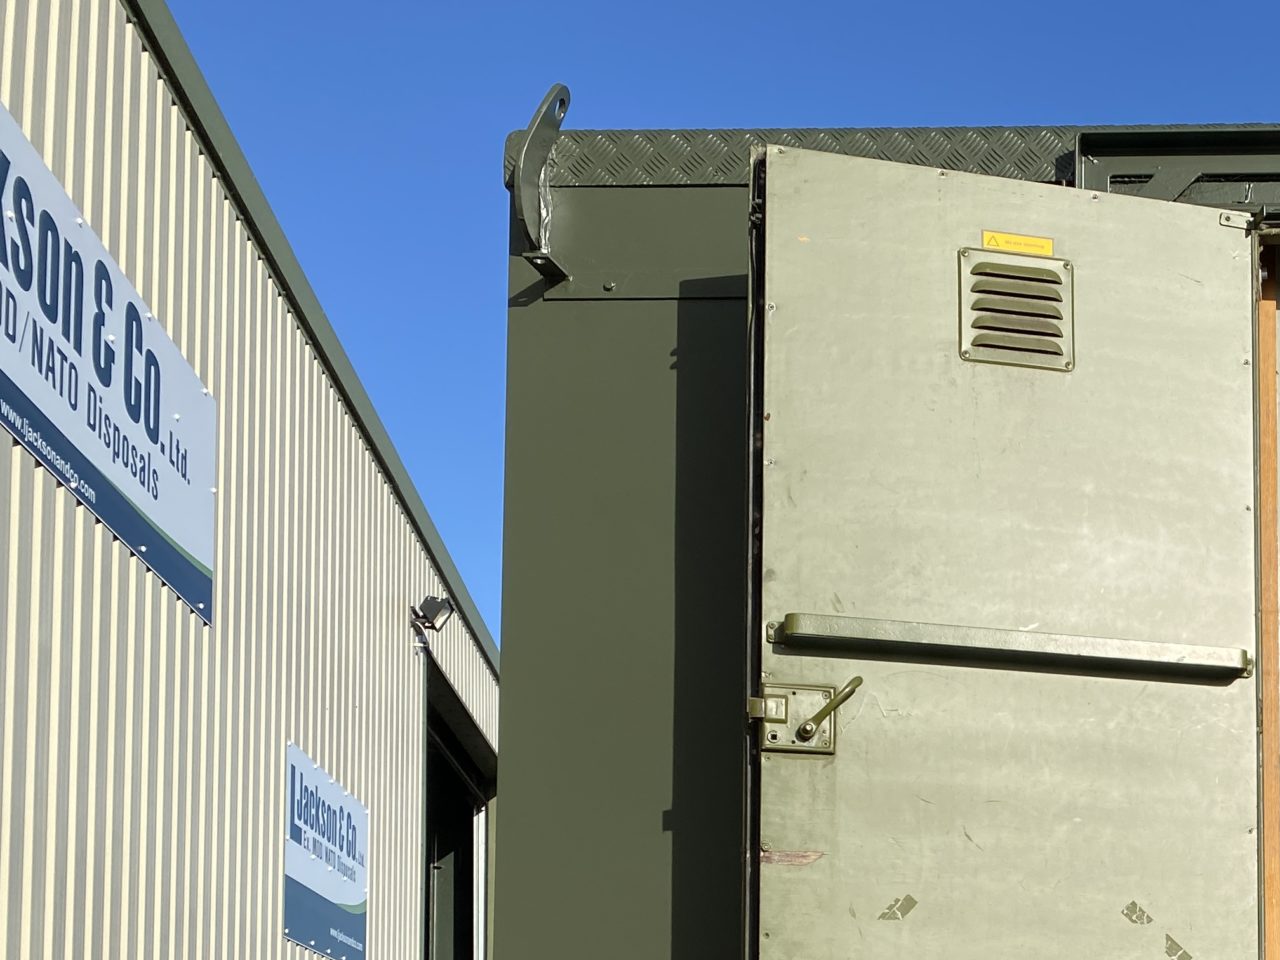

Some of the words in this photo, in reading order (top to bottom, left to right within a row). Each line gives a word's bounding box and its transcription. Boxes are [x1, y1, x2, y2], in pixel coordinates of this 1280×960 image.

[0, 281, 78, 412] D/NATO
[86, 382, 159, 501] Disposals
[0, 398, 97, 504] www.ljacksonandco.com
[92, 259, 115, 388] &
[123, 301, 165, 456] Co.
[169, 430, 191, 486] Ltd.
[296, 771, 337, 848] Jackson
[338, 805, 345, 853] &
